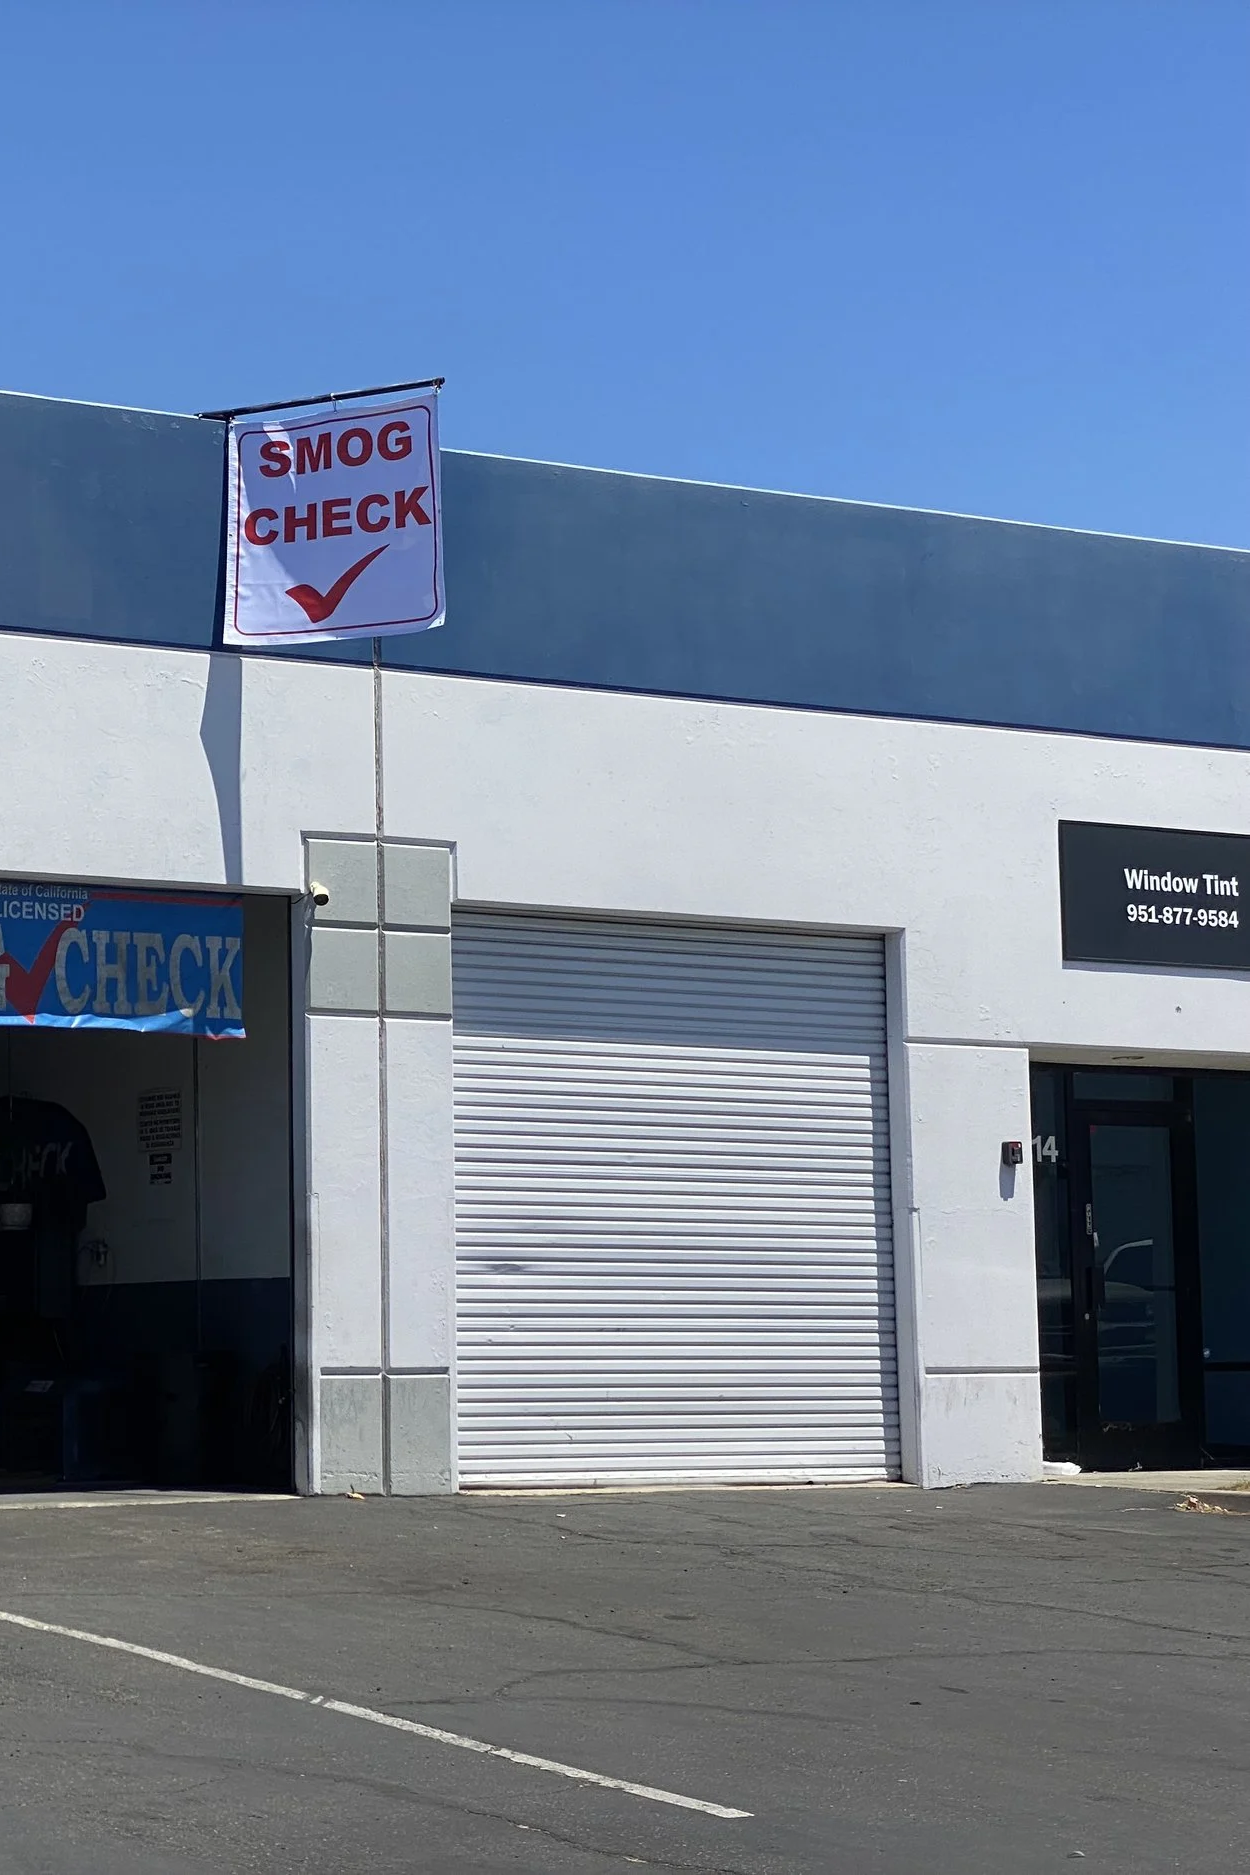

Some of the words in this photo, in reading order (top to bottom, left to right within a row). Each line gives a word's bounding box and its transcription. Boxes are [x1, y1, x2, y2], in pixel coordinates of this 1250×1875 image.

[259, 420, 412, 478] SMOG
[244, 485, 432, 546] CHECK
[21, 884, 32, 897] of
[35, 885, 88, 900] California
[1124, 868, 1199, 894] Window
[1202, 873, 1239, 897] Tint
[1126, 904, 1239, 929] 951-877-9584
[54, 927, 242, 1020] CHECK
